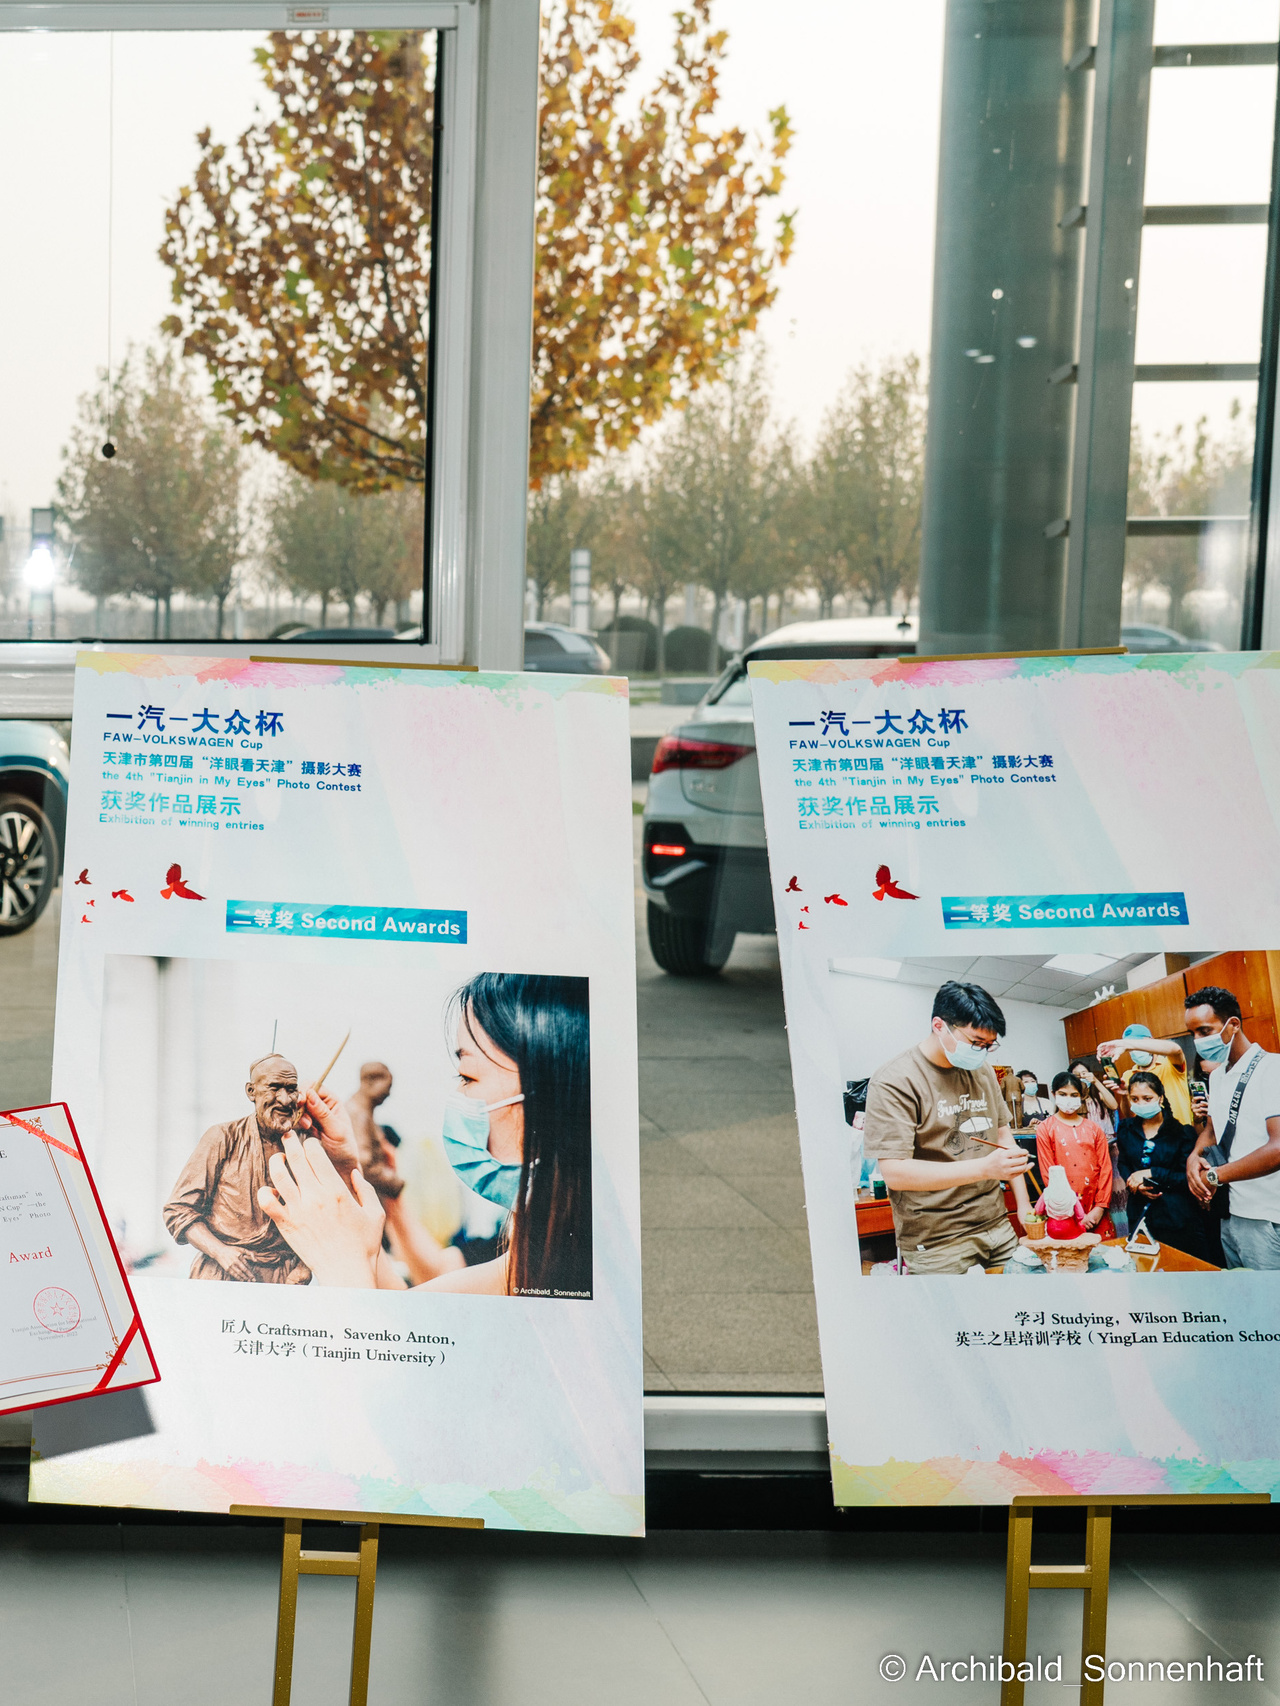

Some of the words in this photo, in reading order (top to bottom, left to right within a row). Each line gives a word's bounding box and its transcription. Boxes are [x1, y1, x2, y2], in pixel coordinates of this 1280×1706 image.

[103, 732, 234, 748] FAW-VOLKSWAGEN
[240, 738, 263, 751] Cup
[789, 738, 921, 749] FAW-VOLKSWAGEN
[927, 737, 950, 749] Cup
[102, 770, 120, 781] the
[125, 771, 143, 782] 4th
[199, 775, 208, 785] in
[214, 775, 231, 788] My
[277, 778, 310, 790] Photo
[316, 781, 362, 792] Contest
[795, 777, 813, 787] the
[818, 776, 836, 787] 4th
[892, 775, 902, 786] in
[907, 775, 925, 787] My
[970, 774, 1004, 785] Photo
[1010, 773, 1057, 784] Contest
[100, 790, 241, 816] 获奖作品展示
[797, 795, 939, 817] 获奖作品展示
[99, 814, 155, 826] Exhibition
[161, 816, 173, 827] of
[179, 818, 219, 831] winning
[225, 820, 265, 831] entries
[799, 819, 855, 830] Exhibition
[861, 819, 873, 829] of
[879, 817, 920, 831] winning
[926, 817, 966, 828] entries
[950, 903, 1012, 923] 二等奖
[1019, 902, 1095, 921] Second
[1102, 899, 1180, 919] Awards
[233, 910, 294, 930] 二等奖
[301, 912, 376, 933] Second
[382, 916, 461, 936] Awards
[28, 1210, 52, 1219] Photo
[9, 1247, 54, 1265] Award
[1014, 1311, 1045, 1326] 学习
[1129, 1312, 1178, 1325] Wilson
[221, 1319, 251, 1336] 匠人
[343, 1327, 401, 1343] Savenko
[955, 1330, 1081, 1347] 英兰之星培训学校
[1162, 1330, 1234, 1345] Education
[233, 1339, 296, 1358] 天津大学
